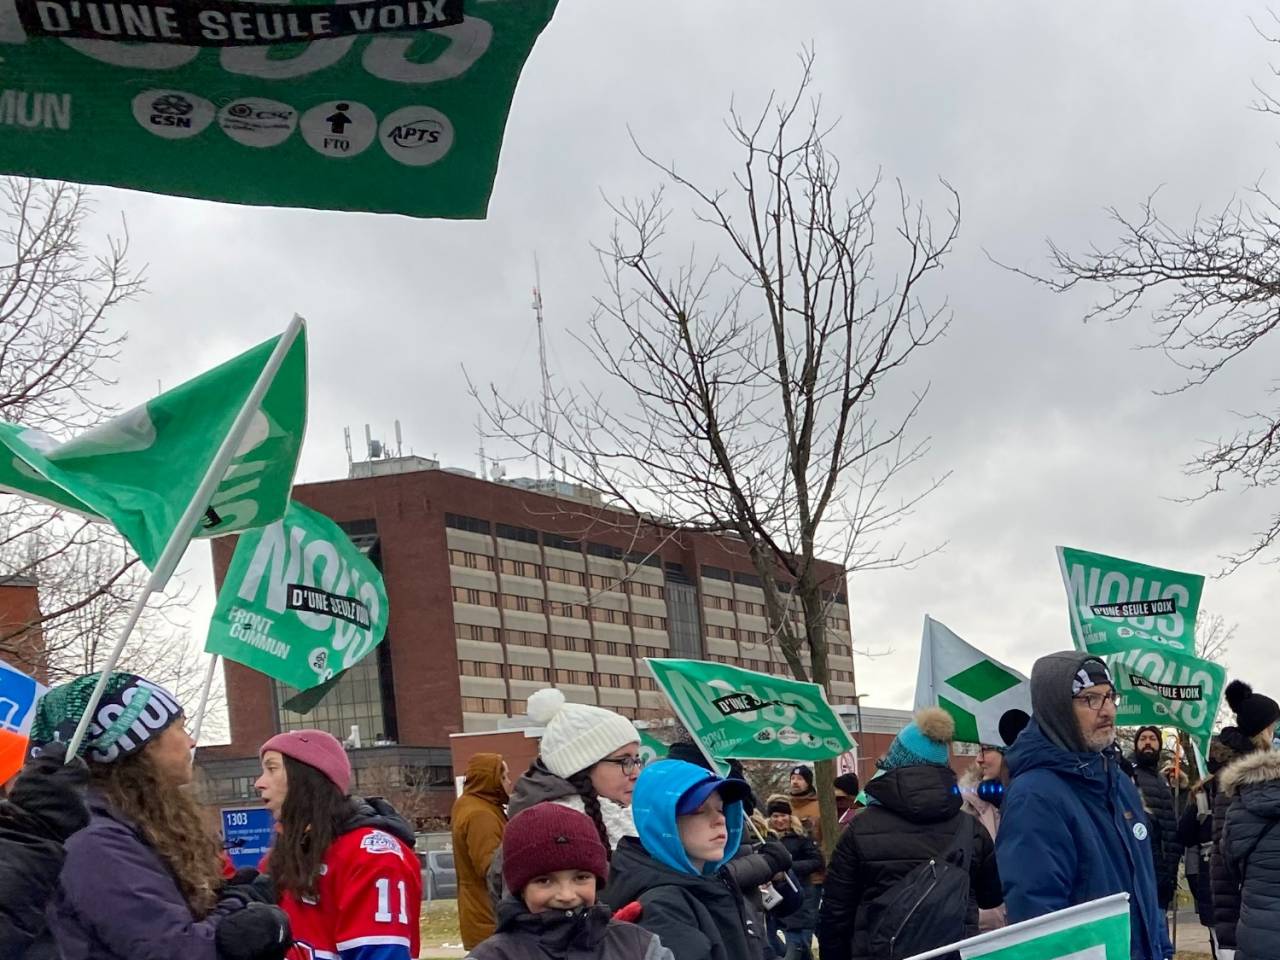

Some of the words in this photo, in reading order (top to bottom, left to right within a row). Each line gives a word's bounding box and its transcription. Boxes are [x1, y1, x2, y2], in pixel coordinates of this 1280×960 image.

[37, 1, 183, 38] D'UNE
[199, 10, 332, 40] SEULE
[350, 0, 447, 31] VOIX
[150, 114, 192, 129] CSN
[387, 125, 440, 143] APTS
[293, 589, 329, 611] D'UNE
[331, 599, 355, 620] SEULE
[1068, 563, 1190, 638] NOUS
[1121, 603, 1149, 616] SEULE
[1151, 601, 1173, 612] VOIX
[228, 605, 275, 633] FRONT
[229, 624, 291, 659] COMMUN
[1179, 687, 1199, 699] VOIX
[226, 812, 248, 826] 1303
[375, 878, 408, 924] 11
